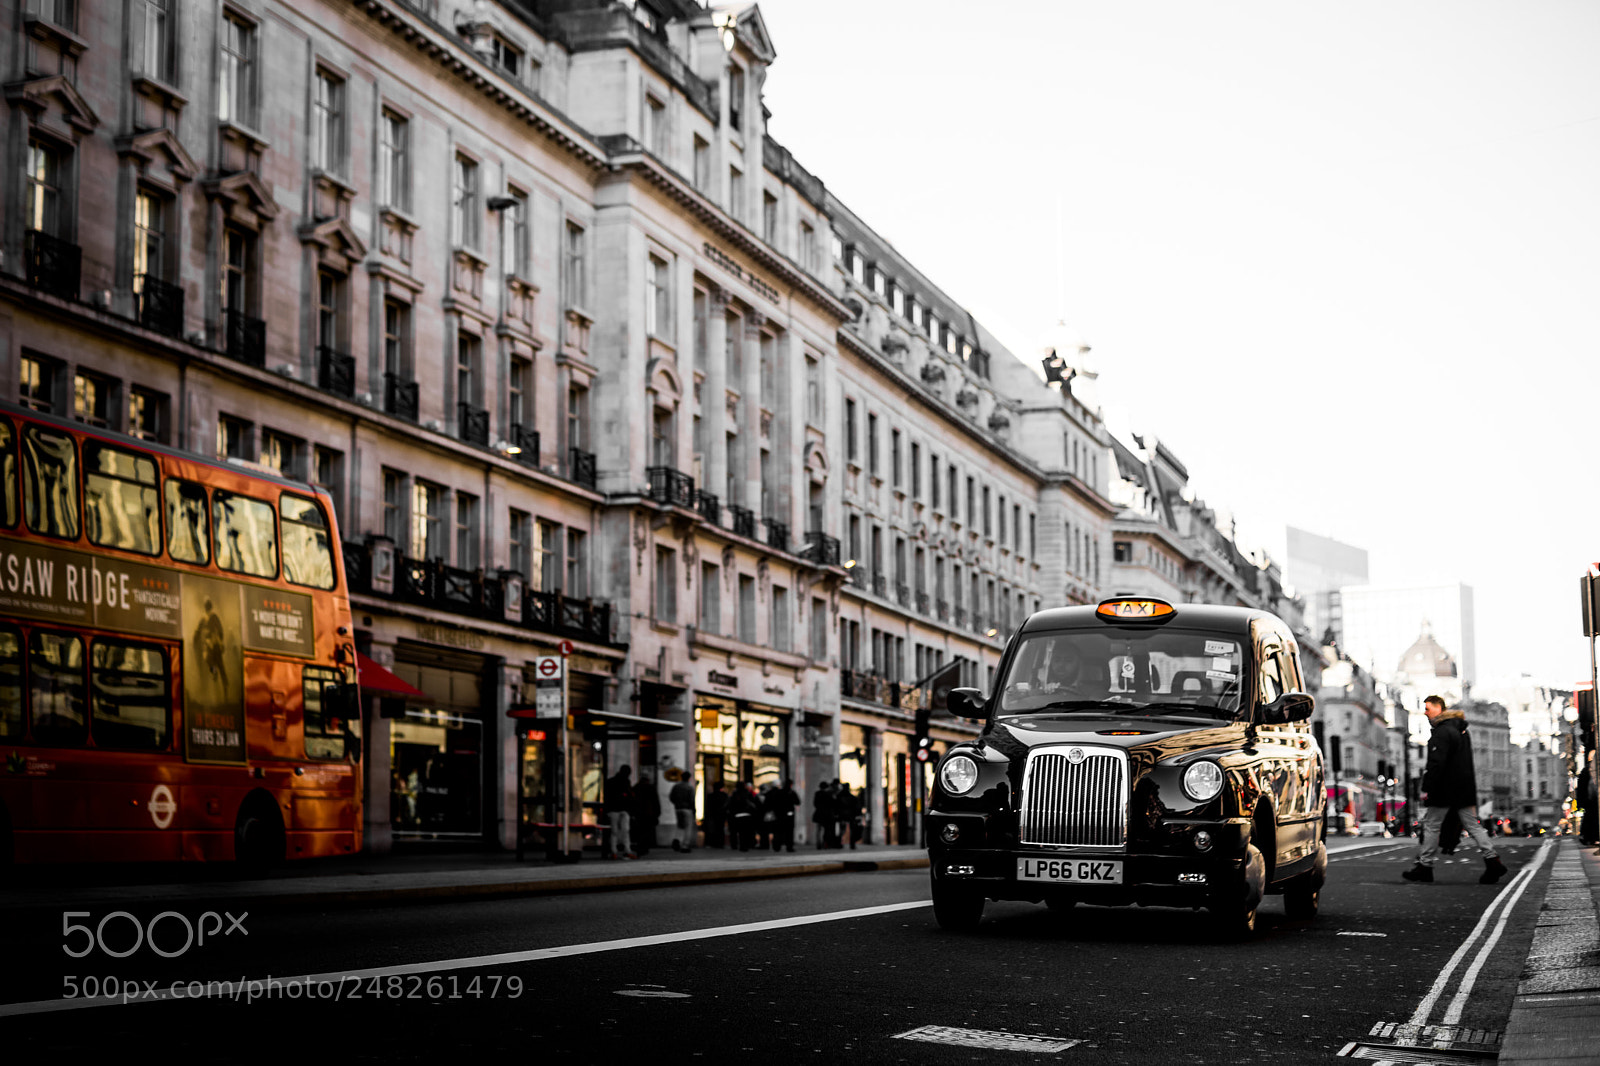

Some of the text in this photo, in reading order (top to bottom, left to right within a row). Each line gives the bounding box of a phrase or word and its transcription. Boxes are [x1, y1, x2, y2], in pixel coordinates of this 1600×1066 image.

[67, 564, 130, 610] RIDGE
[1112, 604, 1156, 614] TAXI
[562, 643, 569, 654] L
[1025, 860, 1114, 880] LP66 GKZ
